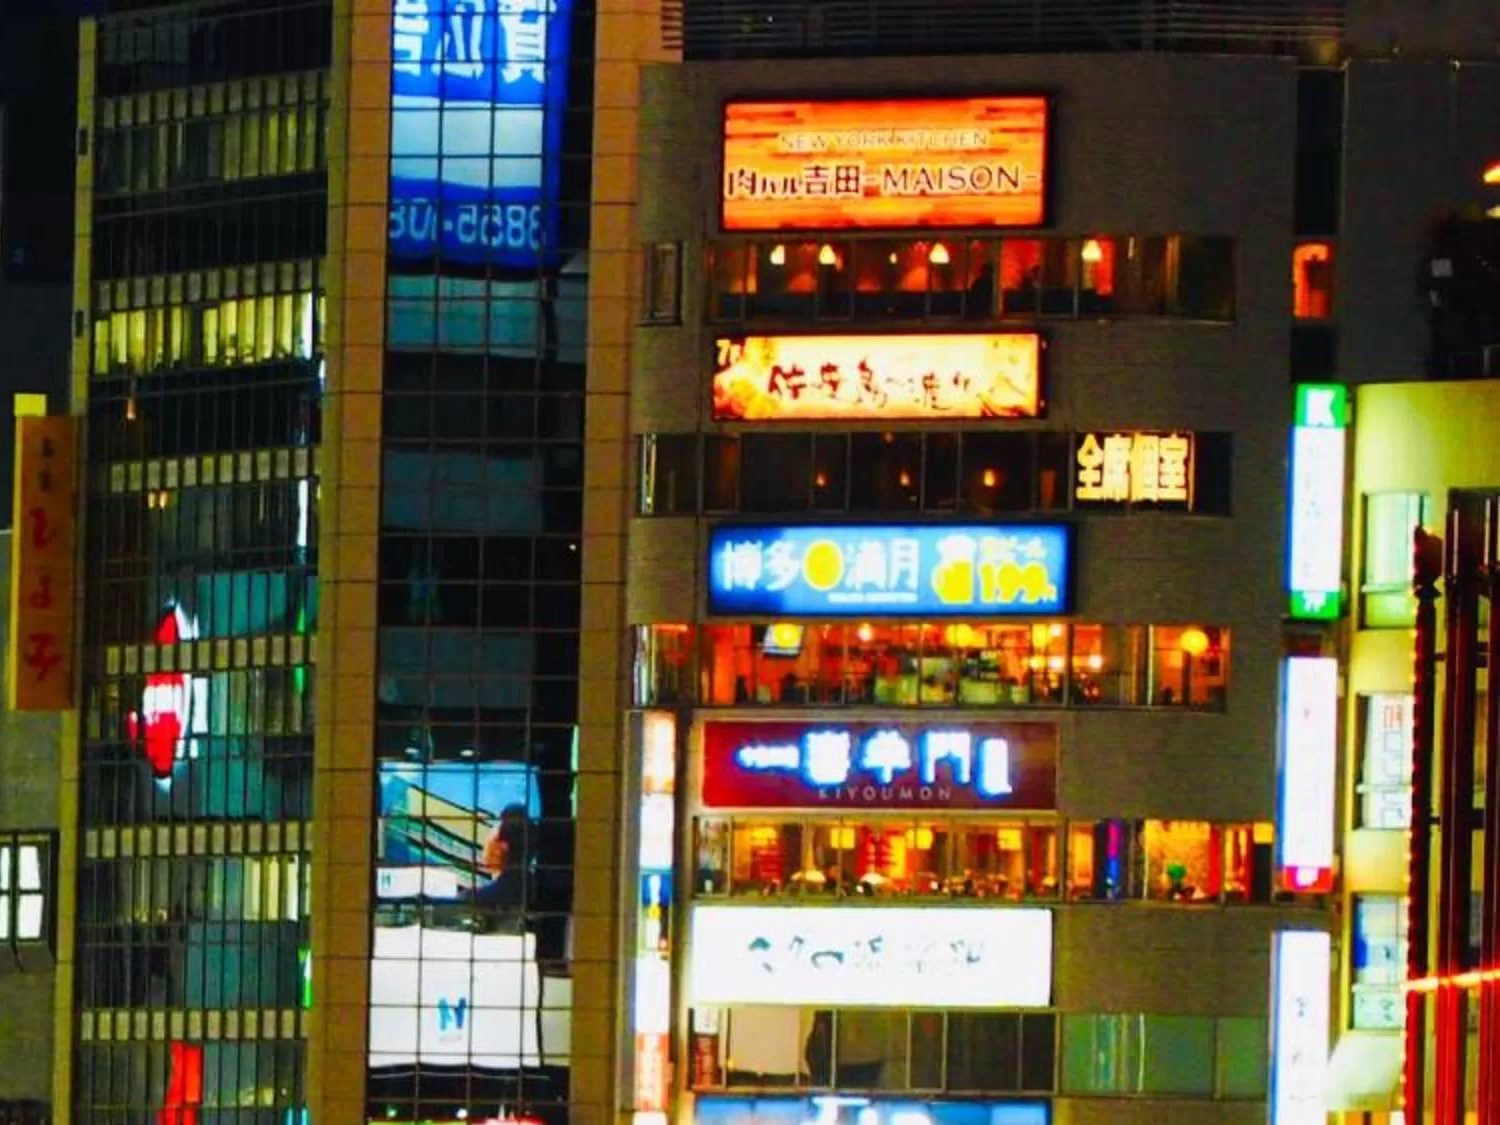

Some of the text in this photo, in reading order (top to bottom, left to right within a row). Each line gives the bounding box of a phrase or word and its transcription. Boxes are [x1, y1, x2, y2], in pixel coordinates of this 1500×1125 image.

[1076, 432, 1190, 502] 全席個室
[818, 784, 951, 801] KIYOUMON
